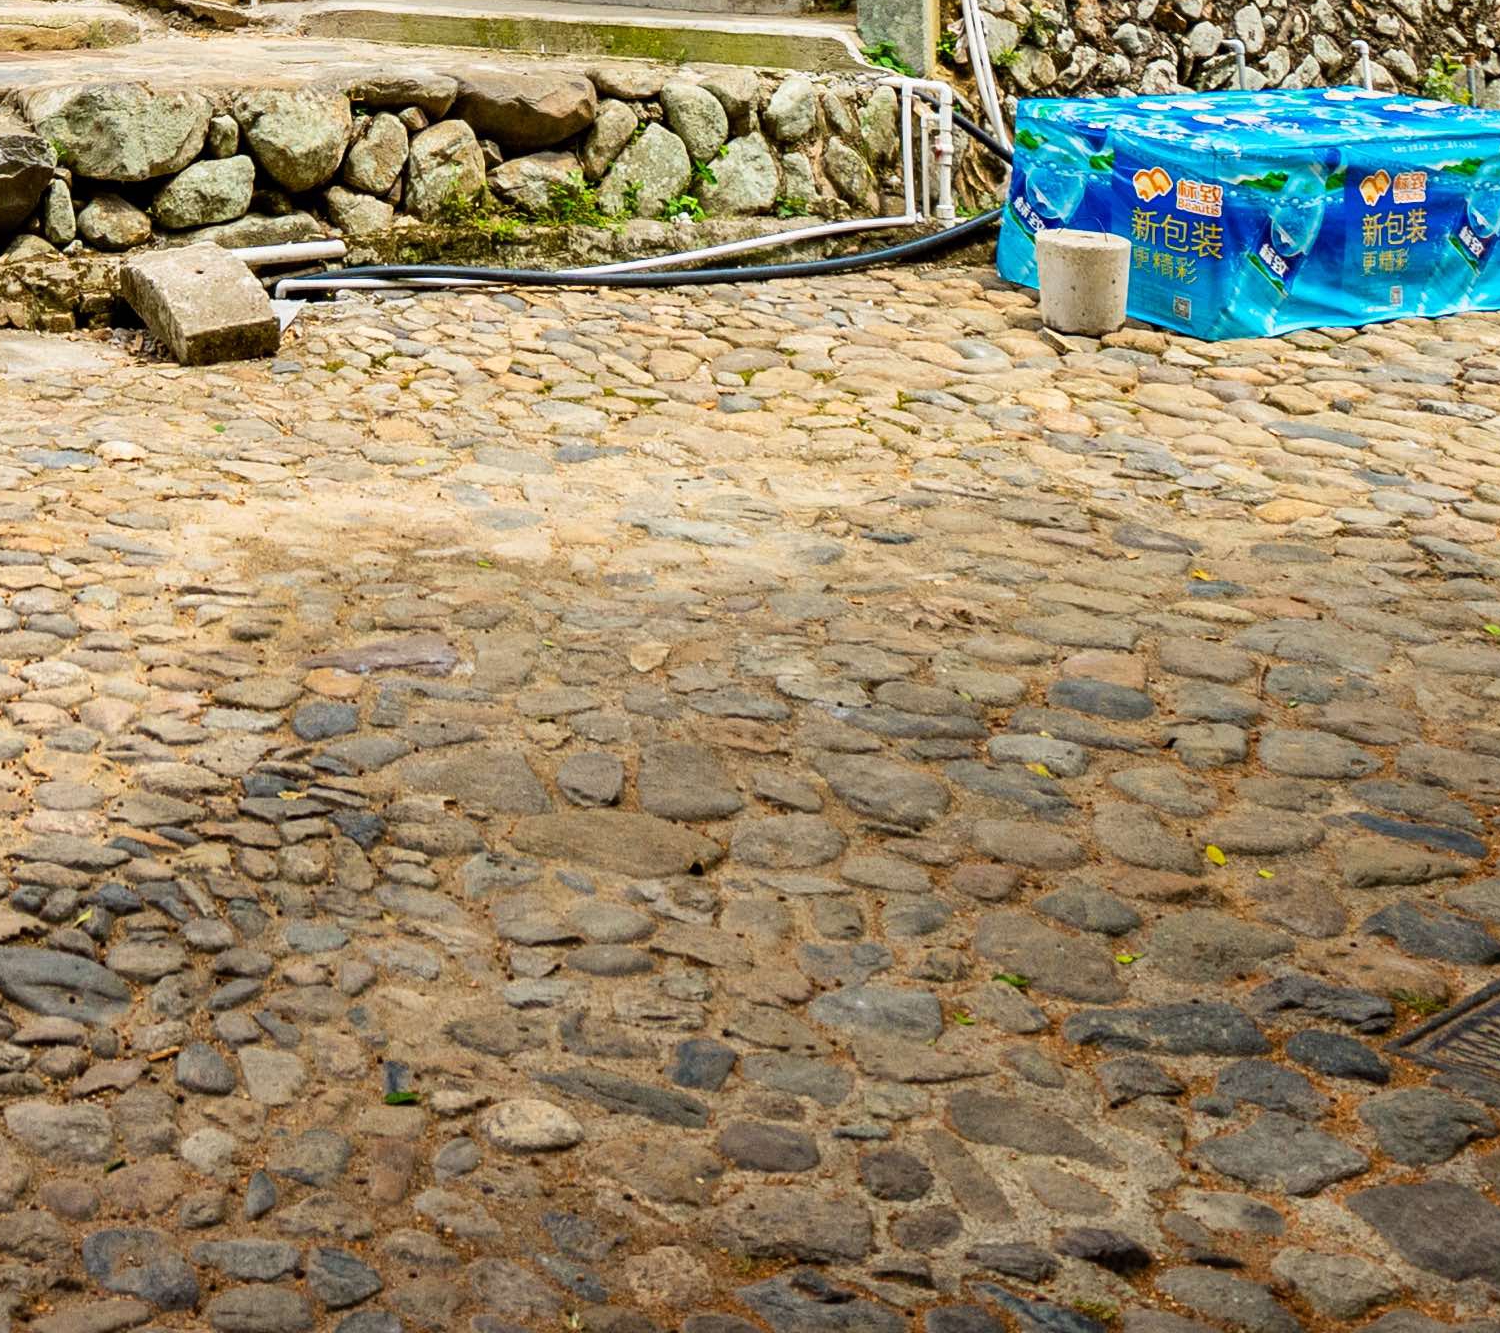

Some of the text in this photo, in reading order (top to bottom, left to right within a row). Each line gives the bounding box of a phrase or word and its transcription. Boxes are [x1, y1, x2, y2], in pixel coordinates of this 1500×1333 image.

[1131, 207, 1225, 260] 新包装
[1361, 208, 1428, 247] 新包装
